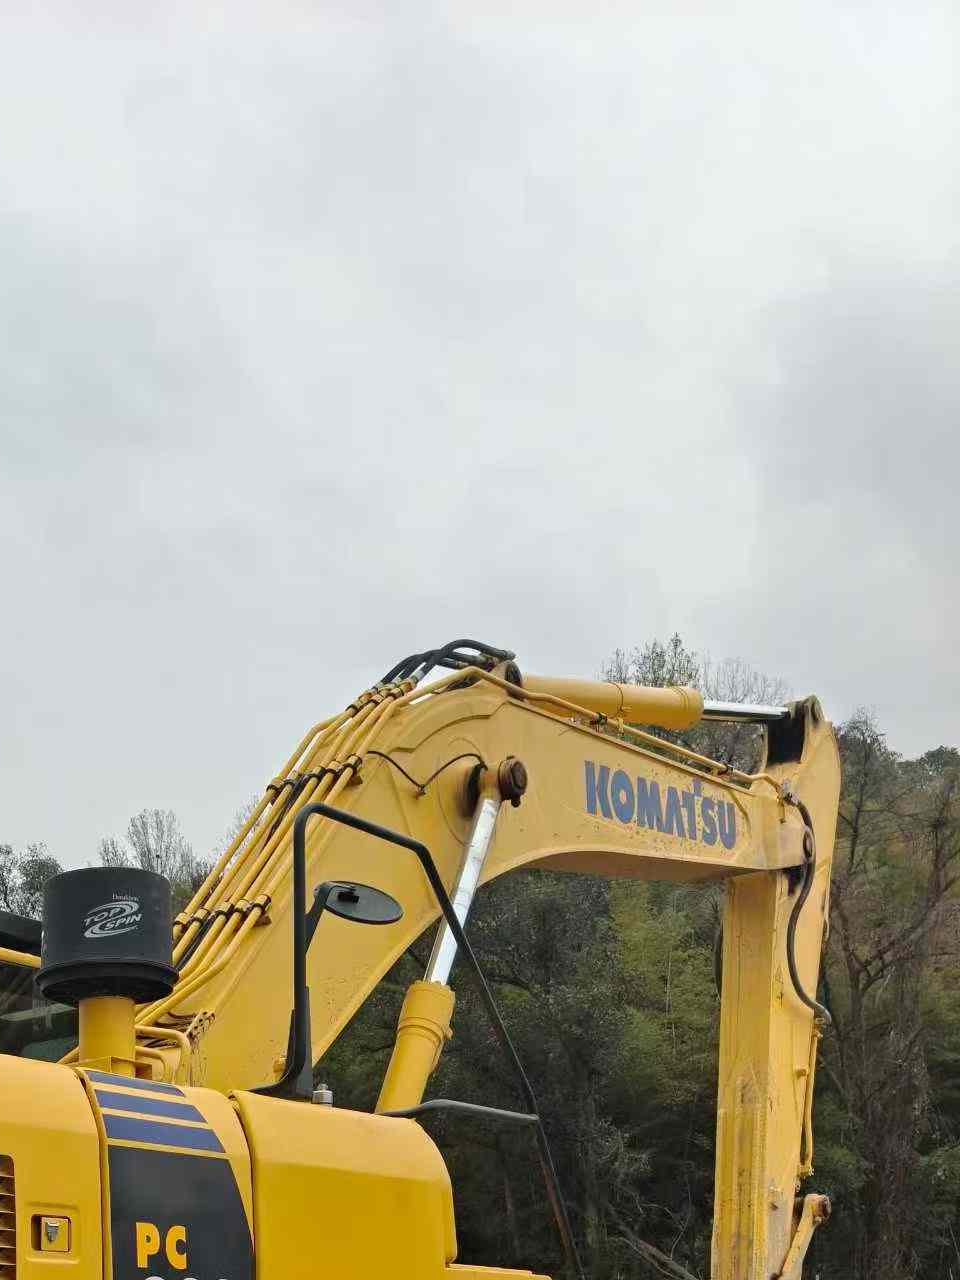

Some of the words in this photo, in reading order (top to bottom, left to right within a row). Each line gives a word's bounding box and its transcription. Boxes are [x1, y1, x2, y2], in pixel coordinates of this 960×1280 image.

[585, 760, 736, 849] KOMATSU
[104, 913, 142, 930] SPIN
[135, 1222, 188, 1270] PC
